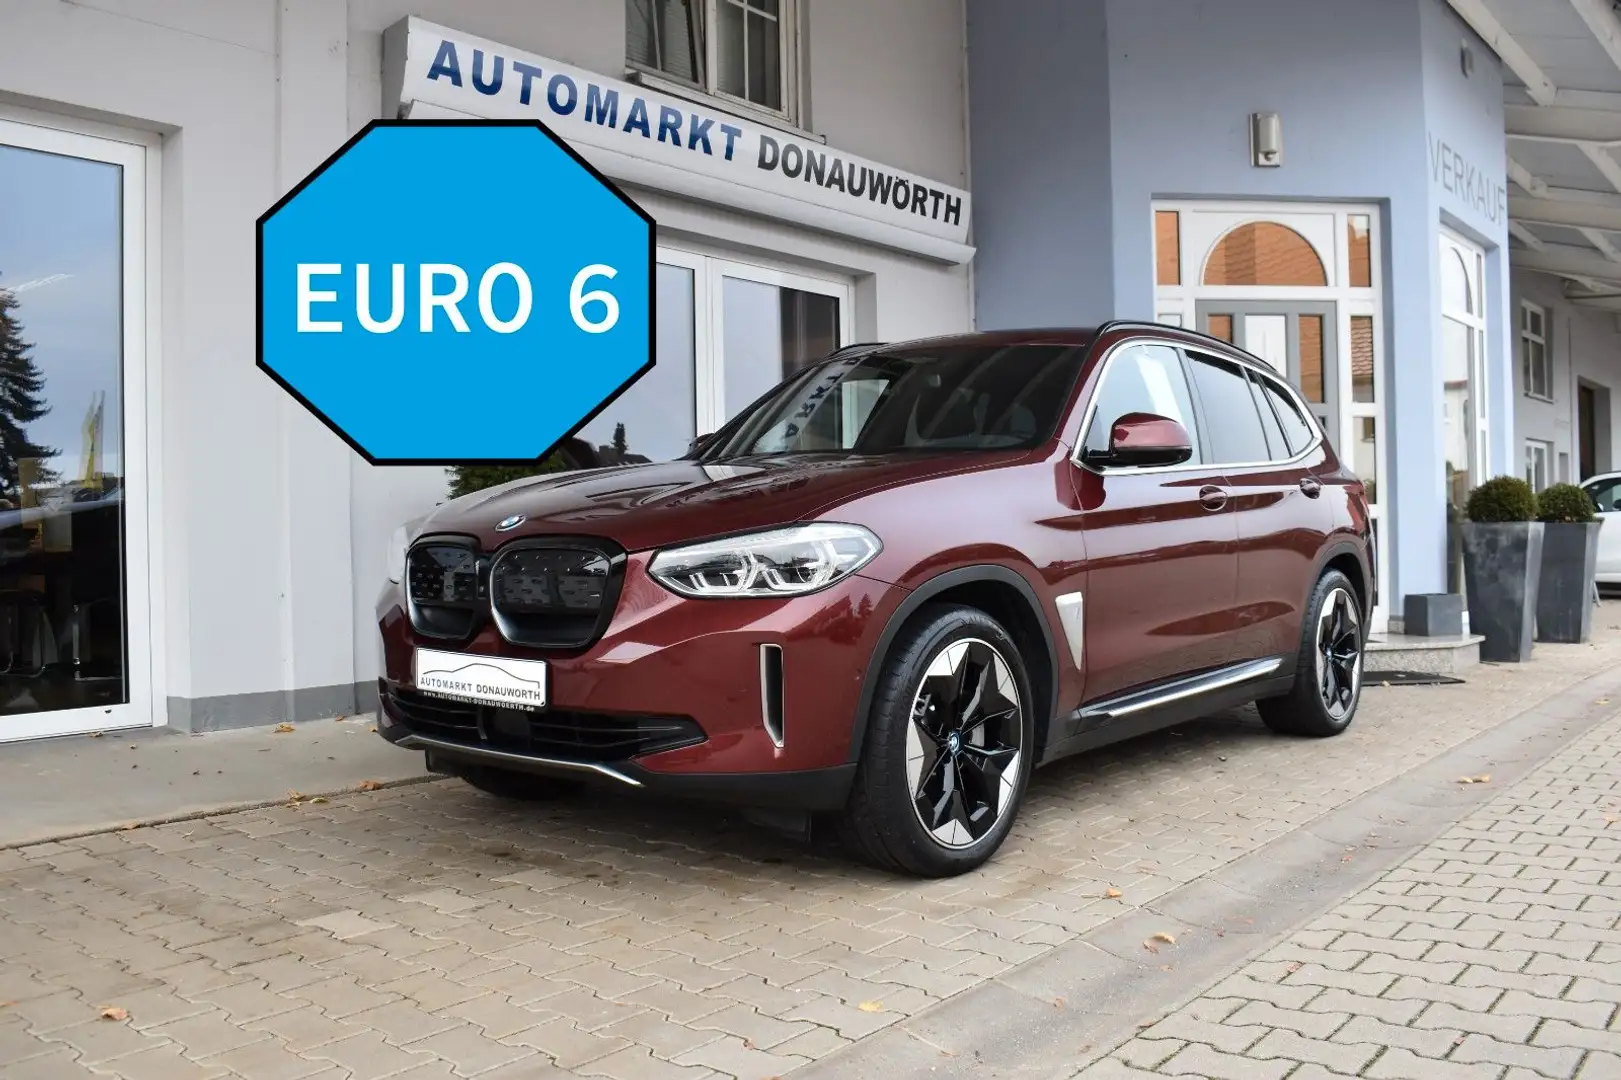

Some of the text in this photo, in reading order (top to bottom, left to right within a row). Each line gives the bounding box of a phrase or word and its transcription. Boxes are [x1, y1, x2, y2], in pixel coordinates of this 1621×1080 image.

[426, 40, 961, 227] AUTOMARKT DONAUWÖRTH
[1428, 131, 1506, 226] VERKAUF
[420, 677, 473, 693] AUTOMARKT
